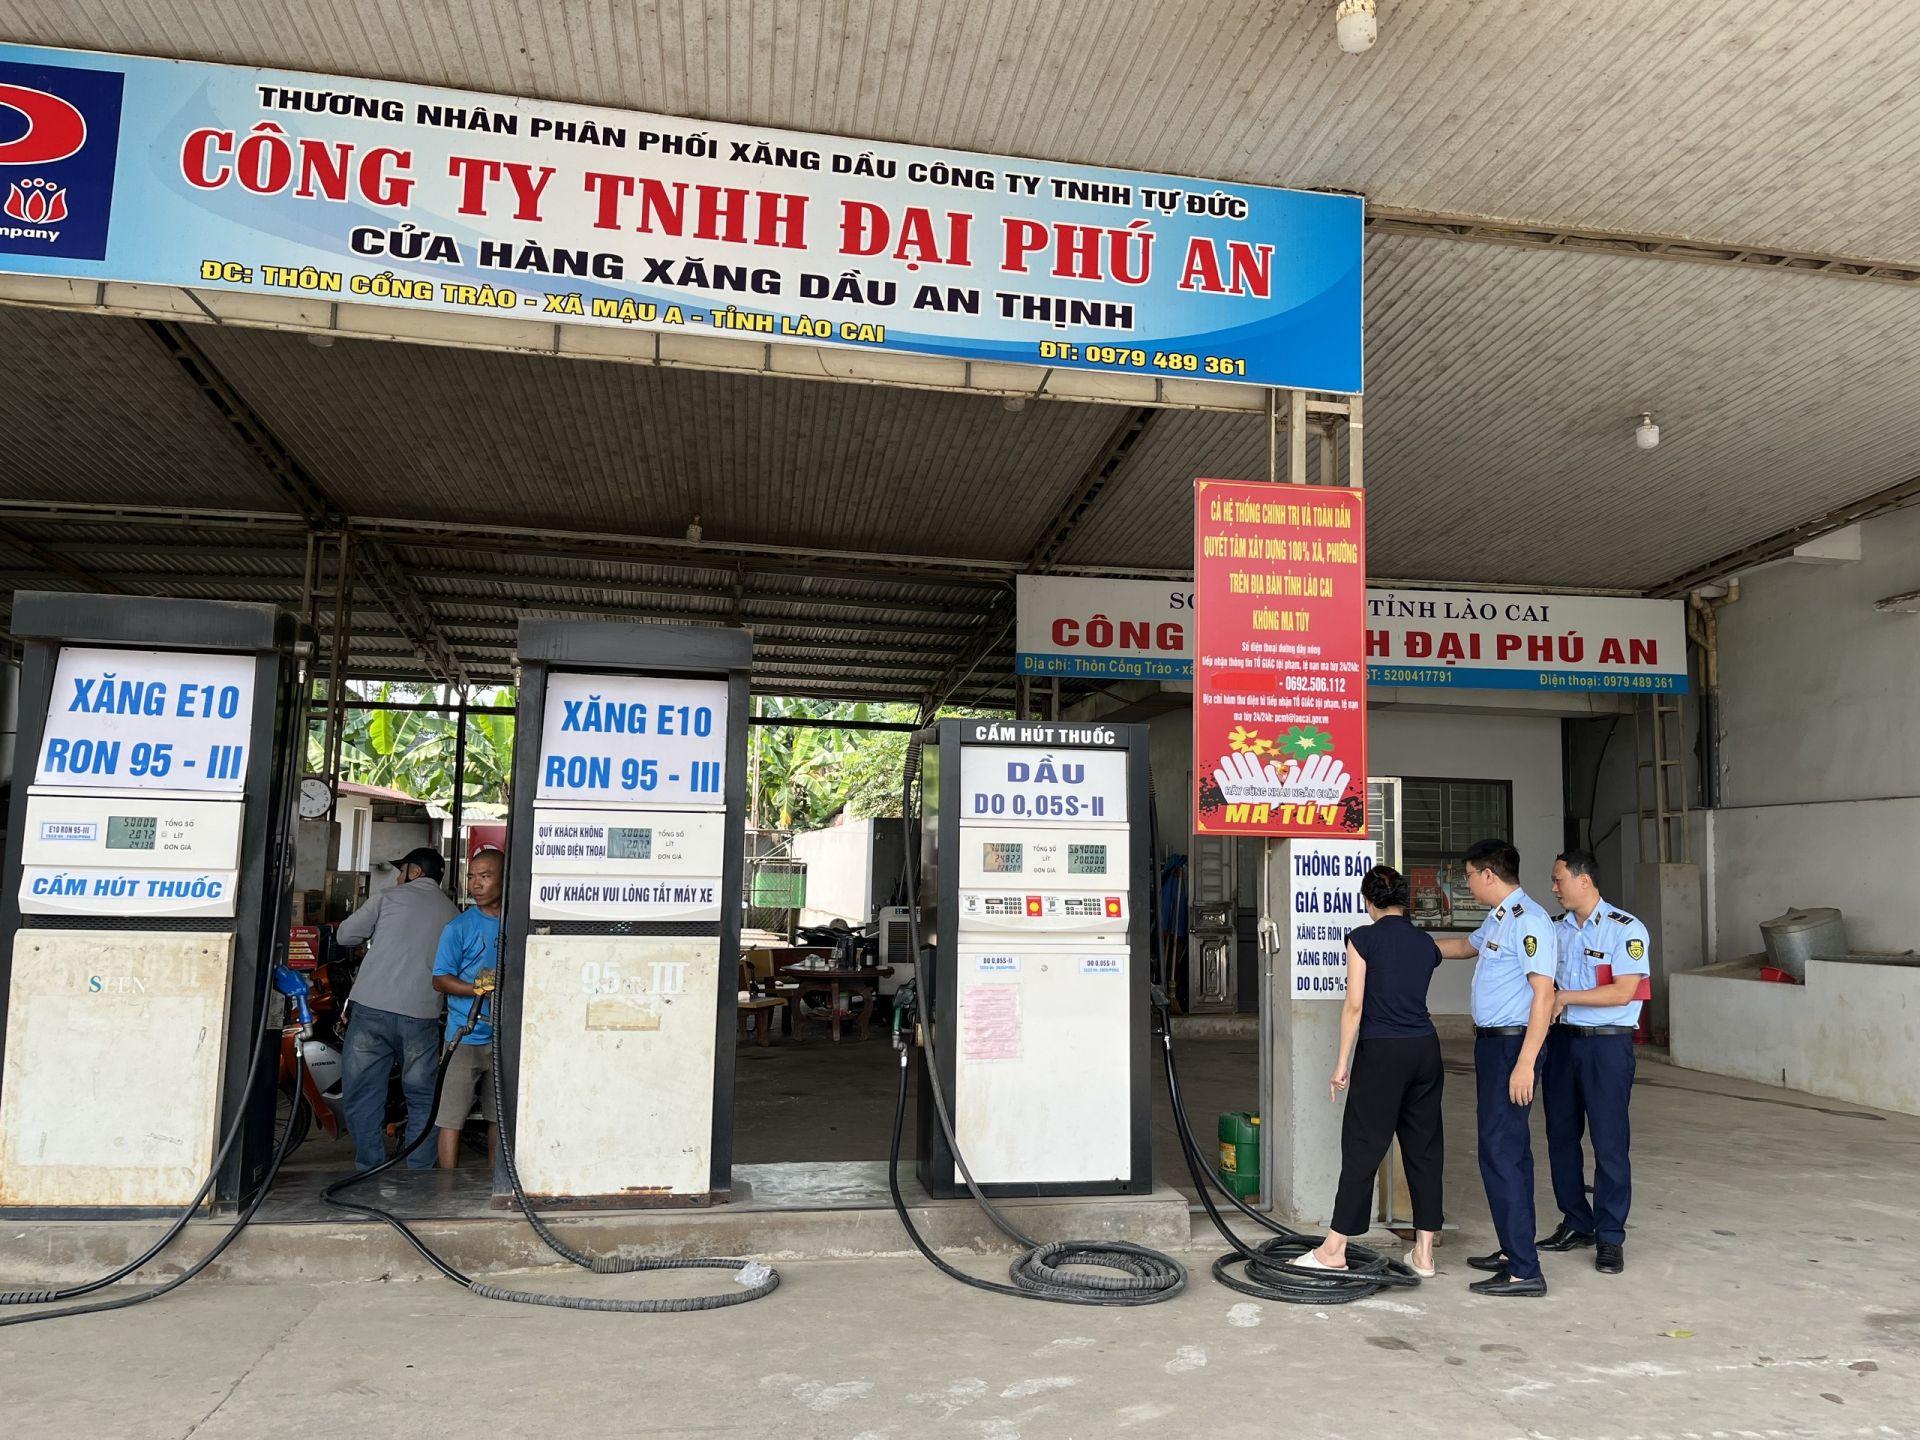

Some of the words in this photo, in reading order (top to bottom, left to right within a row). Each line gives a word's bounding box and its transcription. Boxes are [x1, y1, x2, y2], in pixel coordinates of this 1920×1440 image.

[259, 87, 404, 122] THƯƠNG
[417, 104, 518, 136] NHÂN
[530, 118, 626, 148] PHÂN
[638, 131, 718, 159] PHỐI
[729, 140, 820, 171] XĂNG
[832, 152, 896, 179] DẦU
[908, 162, 994, 190] CÔNG
[1005, 173, 1041, 195] TY
[1050, 179, 1131, 206] TNHH
[1141, 189, 1181, 215] TỰ
[1186, 192, 1247, 218] ĐỨC
[182, 121, 416, 208] CÔNG
[448, 156, 557, 222] TY
[583, 171, 810, 250] TNHH
[838, 199, 973, 271] ĐẠI
[1000, 217, 1155, 285] PHÚ
[1178, 237, 1274, 298] AN
[351, 224, 461, 263] CỬA
[479, 239, 624, 281] HÀNG
[641, 255, 782, 296] XĂNG
[799, 269, 897, 306] DẦU
[912, 285, 980, 315] AN
[995, 292, 1133, 329] THỊNH
[201, 260, 253, 283] ĐC:
[261, 265, 342, 292] THÔN
[350, 271, 433, 300] CỔNG
[440, 282, 517, 309] TRÀO
[524, 297, 537, 306] -
[543, 293, 585, 316] XÃ
[592, 297, 656, 323] MẬU
[663, 305, 685, 325] A
[710, 305, 774, 333] TỈNH
[781, 315, 832, 338] LÀO
[839, 322, 885, 343] CAI
[1039, 341, 1078, 360] ĐT:
[1085, 345, 1147, 367] 0979
[1152, 352, 1199, 371] 489
[1204, 356, 1247, 376] 361
[1210, 494, 1222, 521] CẢ
[1223, 498, 1234, 526] HỆ
[1235, 496, 1261, 523] THỐNG
[1262, 500, 1286, 525] CHÍNH
[1288, 505, 1300, 530] TRỊ
[1301, 502, 1312, 527] VÀ
[1313, 503, 1333, 528] TOÀN
[1204, 530, 1229, 558] QUYẾT
[1230, 534, 1247, 558] TÂM
[1247, 535, 1264, 559] XÂY
[1265, 539, 1287, 564] DỰNG
[1288, 540, 1310, 562] 100%
[1311, 538, 1325, 564] XÃ,
[1326, 538, 1358, 564] PHƯỜNG
[1229, 569, 1249, 593] TRÊN
[1251, 573, 1264, 599] ĐỊA
[1266, 571, 1282, 595] BÀN
[1284, 569, 1302, 597] TỈNH
[1303, 573, 1318, 598] LÀO
[1319, 577, 1333, 598] CAI
[1252, 606, 1280, 631] KHÔNG
[1281, 611, 1294, 632] MA
[1295, 608, 1310, 632] TÚY
[1368, 594, 1437, 618] TỈNH
[1443, 598, 1498, 620] LÀO
[1505, 604, 1550, 622] CAI
[1051, 614, 1184, 651] CÔNG
[1404, 630, 1481, 665] ĐẠI
[1496, 630, 1584, 663] PHÚ
[1598, 637, 1658, 665] AN
[1024, 657, 1045, 673] Địa
[1075, 658, 1105, 672] Thôn
[1285, 675, 1346, 693] 0692.506.112
[1384, 670, 1453, 682] 5200417791
[1539, 673, 1566, 688] Điện
[1568, 675, 1601, 689] thoại:
[1603, 675, 1630, 687] 0979
[1632, 676, 1652, 688] 489
[1654, 677, 1673, 688] 361
[68, 672, 167, 718] XĂNG
[176, 683, 240, 720] E10
[561, 694, 647, 734] XĂNG
[657, 704, 712, 737] E10
[975, 723, 1016, 742] CẤM
[1020, 725, 1055, 743] HÚT
[1058, 727, 1116, 745] THUỐC
[43, 738, 121, 776] RON
[128, 742, 174, 777] 95
[206, 745, 243, 780] III
[1007, 754, 1085, 784] DẦU
[545, 755, 611, 788] RON
[621, 758, 658, 791] 95
[690, 761, 720, 793] III
[974, 793, 1005, 815] DO
[1012, 794, 1104, 818] 0,05S-II
[1267, 787, 1292, 798] NHAU
[1224, 802, 1271, 825] MA
[1280, 800, 1340, 826] TÚY
[538, 824, 553, 839] QUÝ
[554, 825, 578, 838] KHÁCH
[579, 825, 604, 838] KHÔNG
[535, 842, 546, 856] SỬ
[546, 844, 565, 858] DỤNG
[567, 843, 584, 858] ĐIỆN
[586, 845, 606, 859] THOẠI
[1294, 850, 1340, 877] THÔNG
[1344, 851, 1372, 877] BÁO
[32, 873, 87, 896] CẤM
[94, 876, 140, 897] HÚT
[147, 875, 223, 898] THUỐC
[540, 883, 561, 902] QUÝ
[564, 883, 599, 902] KHÁCH
[602, 887, 619, 902] VUI
[622, 884, 650, 902] LÒNG
[653, 882, 672, 902] TẮT
[674, 884, 697, 903] MÁY
[699, 887, 713, 903] XE
[1295, 886, 1319, 914] GIÁ
[1323, 887, 1352, 914] BÁN
[1296, 923, 1316, 940] XĂNG
[1317, 926, 1326, 941] E5
[1327, 926, 1342, 941] RON
[1297, 948, 1320, 966] XĂNG
[1322, 951, 1340, 966] RON
[1297, 976, 1310, 991] DO
